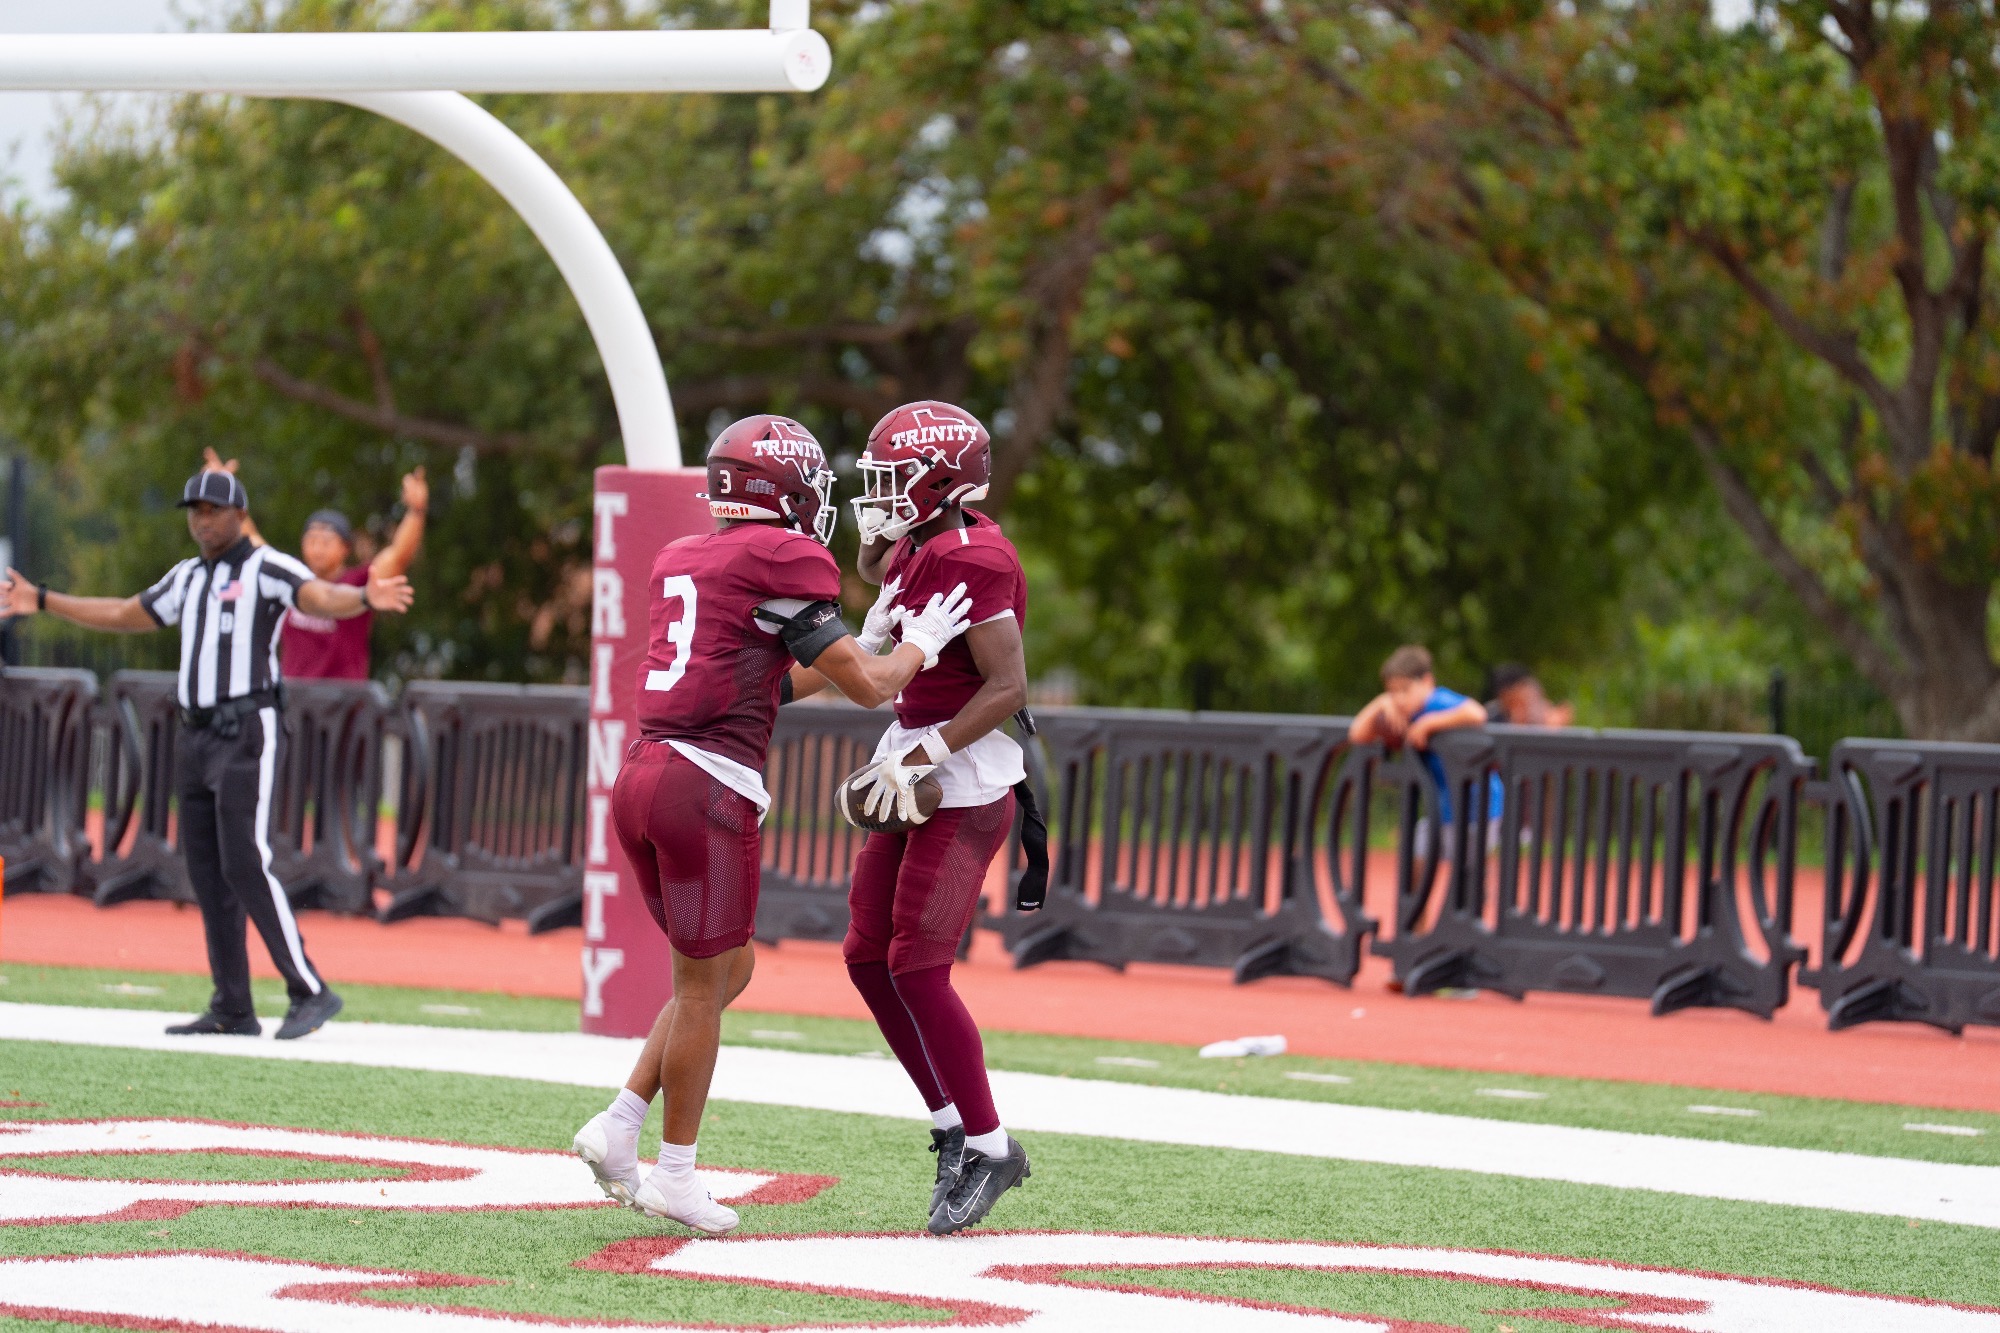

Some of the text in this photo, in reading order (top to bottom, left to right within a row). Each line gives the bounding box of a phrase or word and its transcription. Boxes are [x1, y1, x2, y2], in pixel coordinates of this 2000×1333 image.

[891, 424, 979, 450] TRINITY
[719, 469, 732, 494] 3
[645, 574, 698, 692] 3
[582, 491, 628, 1018] TRINITY
